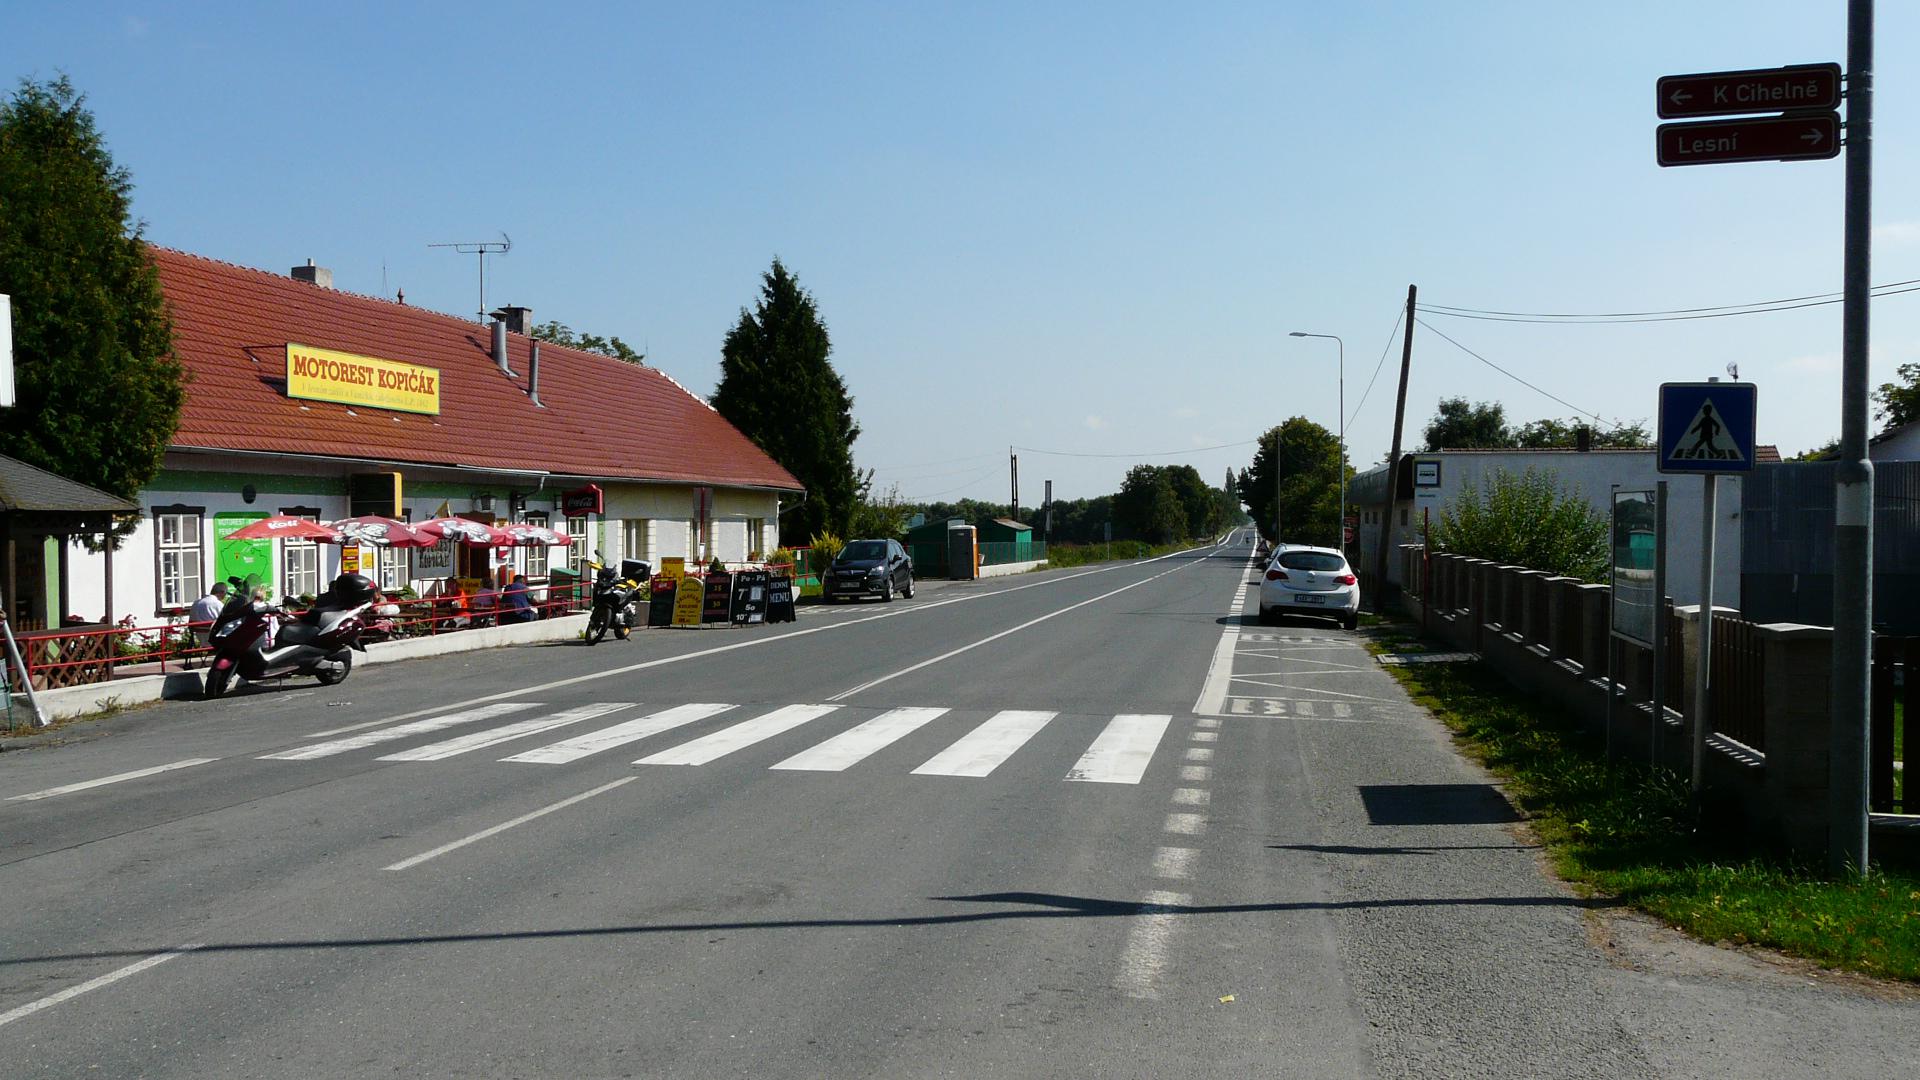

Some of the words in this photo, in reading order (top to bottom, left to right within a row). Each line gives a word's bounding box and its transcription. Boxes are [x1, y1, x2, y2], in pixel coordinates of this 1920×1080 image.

[1713, 86, 1728, 104] K
[1736, 80, 1819, 103] Cihelně
[1677, 132, 1738, 155] Lesní
[293, 354, 374, 386] MOTOREST
[377, 368, 435, 395] KOPIČÁK
[769, 592, 790, 603] MENU
